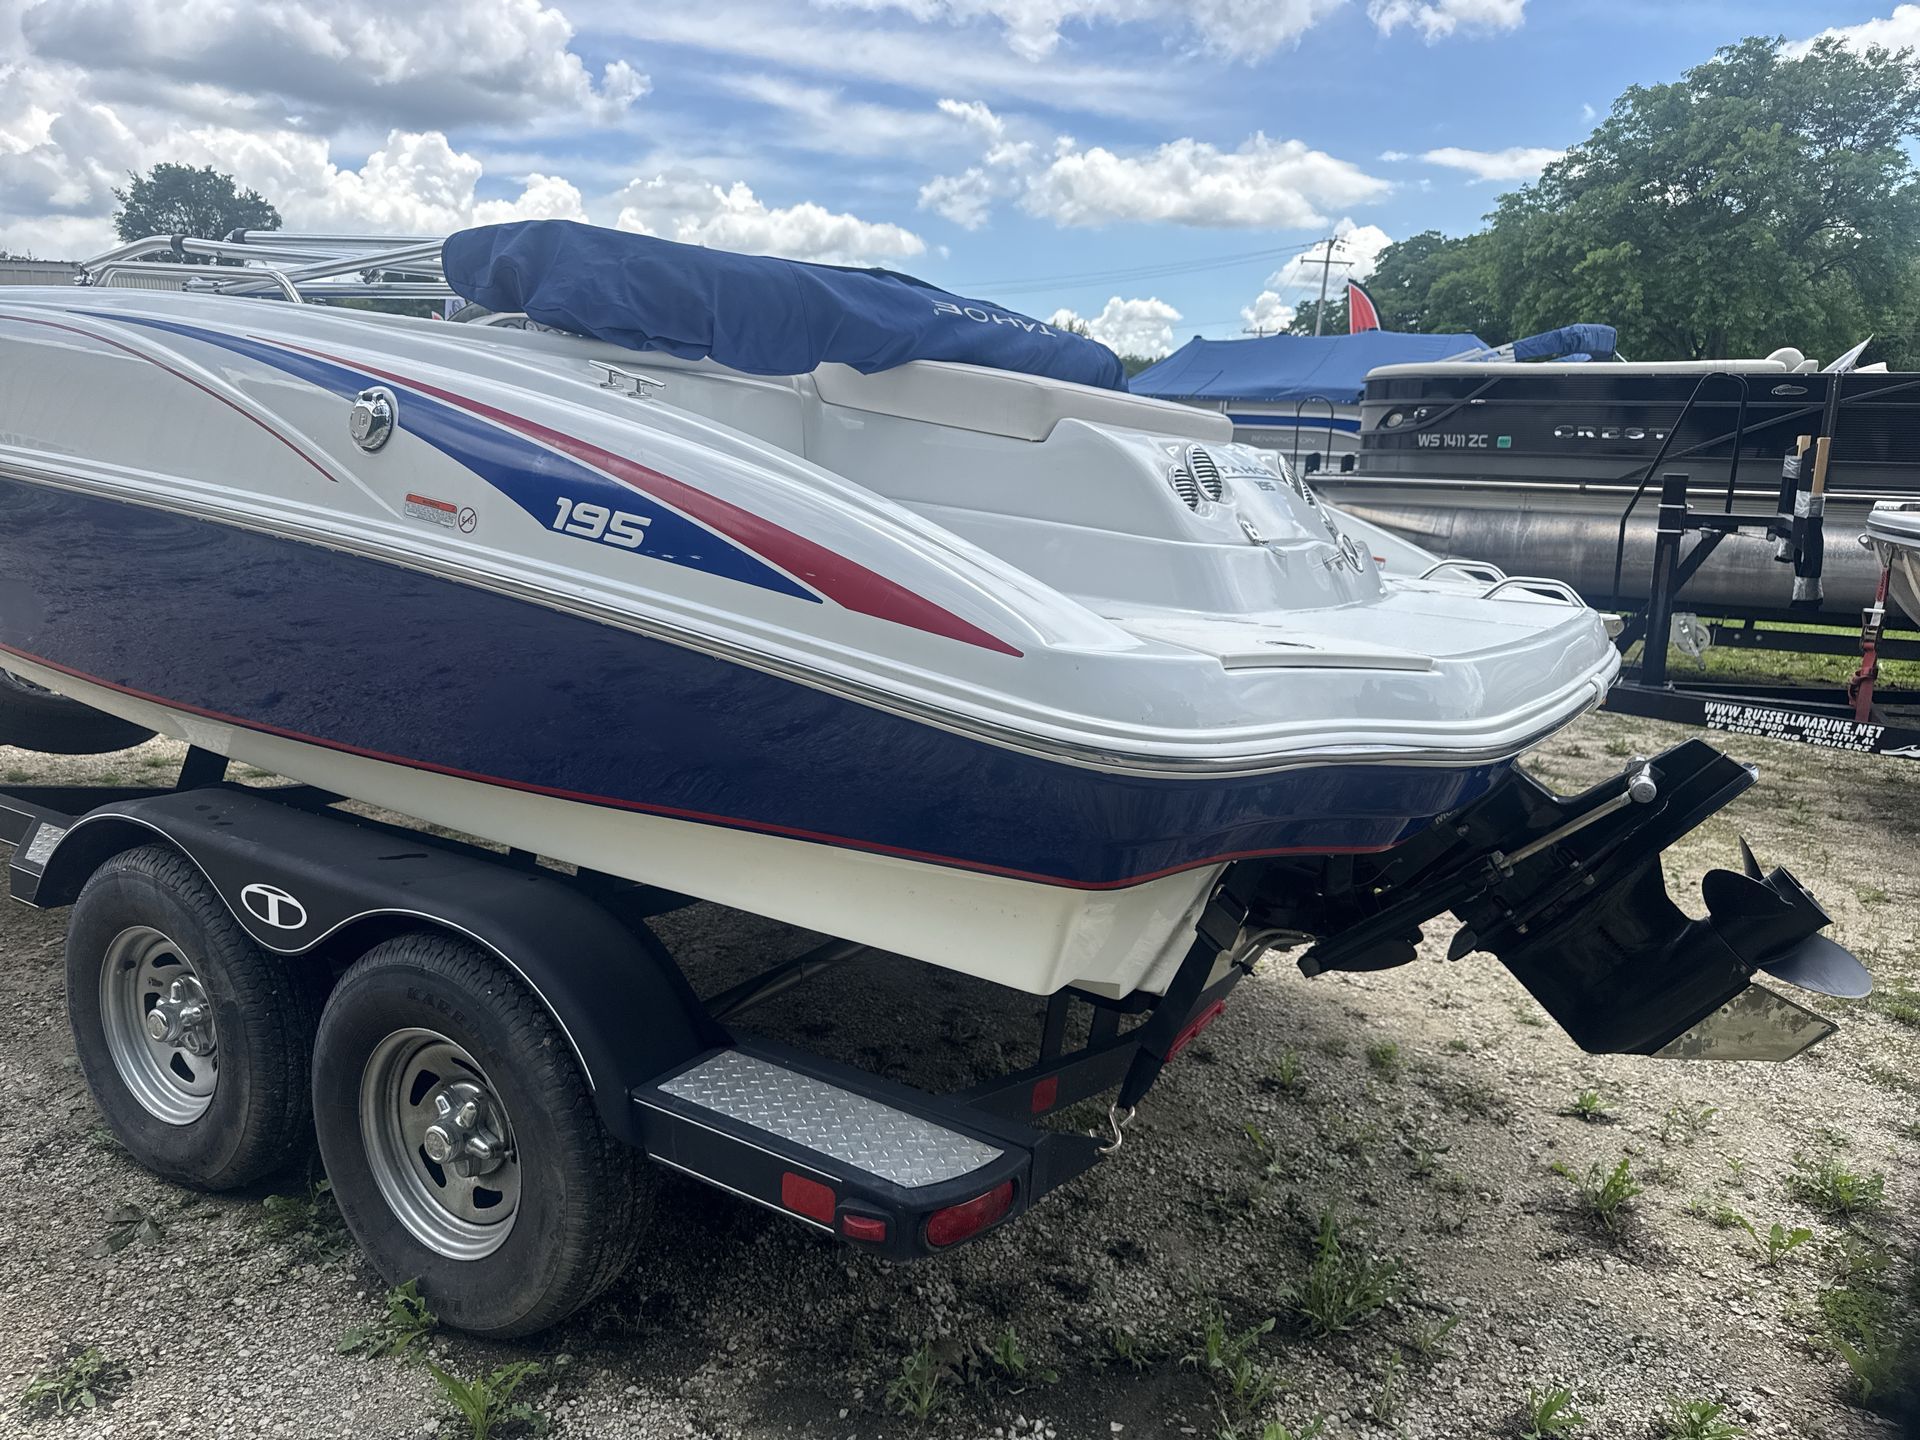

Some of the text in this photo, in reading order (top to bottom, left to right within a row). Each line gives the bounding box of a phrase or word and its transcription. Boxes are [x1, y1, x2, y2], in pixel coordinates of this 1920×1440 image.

[1418, 433, 1440, 448] WS
[1443, 433, 1465, 448] 1411
[1468, 434, 1488, 448] ZC
[1554, 424, 1672, 440] CREST
[553, 497, 652, 549] 195
[1704, 701, 1885, 739] WWW.RUSSELLMARINE.NET
[1707, 721, 1871, 752] BY ROAD KING TRAILERS
[1862, 737, 1876, 747] AL
